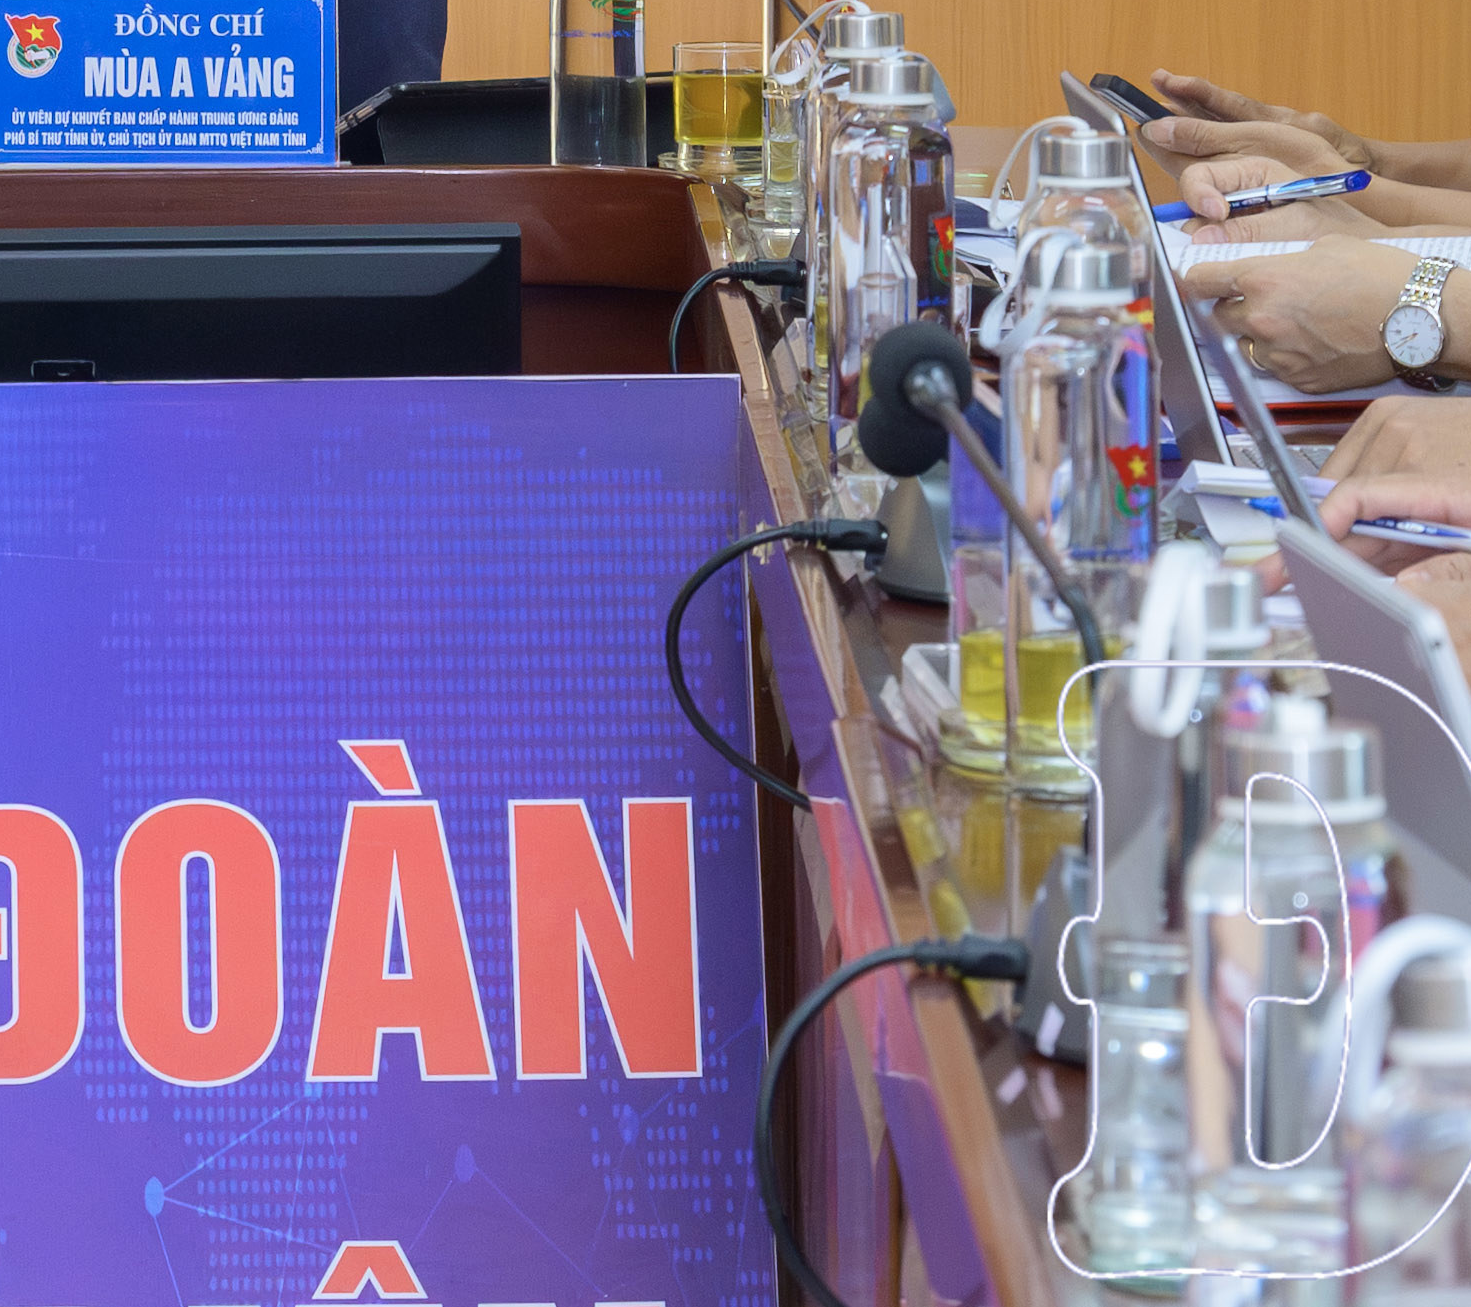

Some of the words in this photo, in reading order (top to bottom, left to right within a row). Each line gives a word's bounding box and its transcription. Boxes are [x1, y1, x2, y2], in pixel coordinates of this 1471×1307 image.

[114, 3, 201, 37] ĐỒNG
[209, 7, 264, 37] CHÍ
[84, 48, 161, 98] MÙA
[170, 56, 194, 98] A
[203, 43, 295, 98] VẢNG
[12, 107, 26, 125] ỦY
[28, 109, 53, 125] VIÊN
[54, 110, 71, 128] DỰ
[72, 107, 112, 125] KHUYẾT
[114, 111, 136, 125] BAN
[138, 107, 167, 125] CHẤP
[169, 109, 199, 126] HÀNH
[201, 111, 236, 126] TRUNG
[238, 110, 268, 126] ƯƠNG
[3, 129, 26, 146] PHÓ
[28, 129, 39, 146] BÍ
[41, 131, 63, 146] THƯ
[91, 128, 106, 147] ỦY,
[108, 128, 130, 146] CHỦ
[132, 132, 156, 149] TỊCH
[158, 128, 173, 146] ỦY
[175, 132, 197, 146] BAN
[199, 132, 228, 147] MTTQ
[230, 130, 253, 149] VIỆT
[255, 132, 280, 147] NAM
